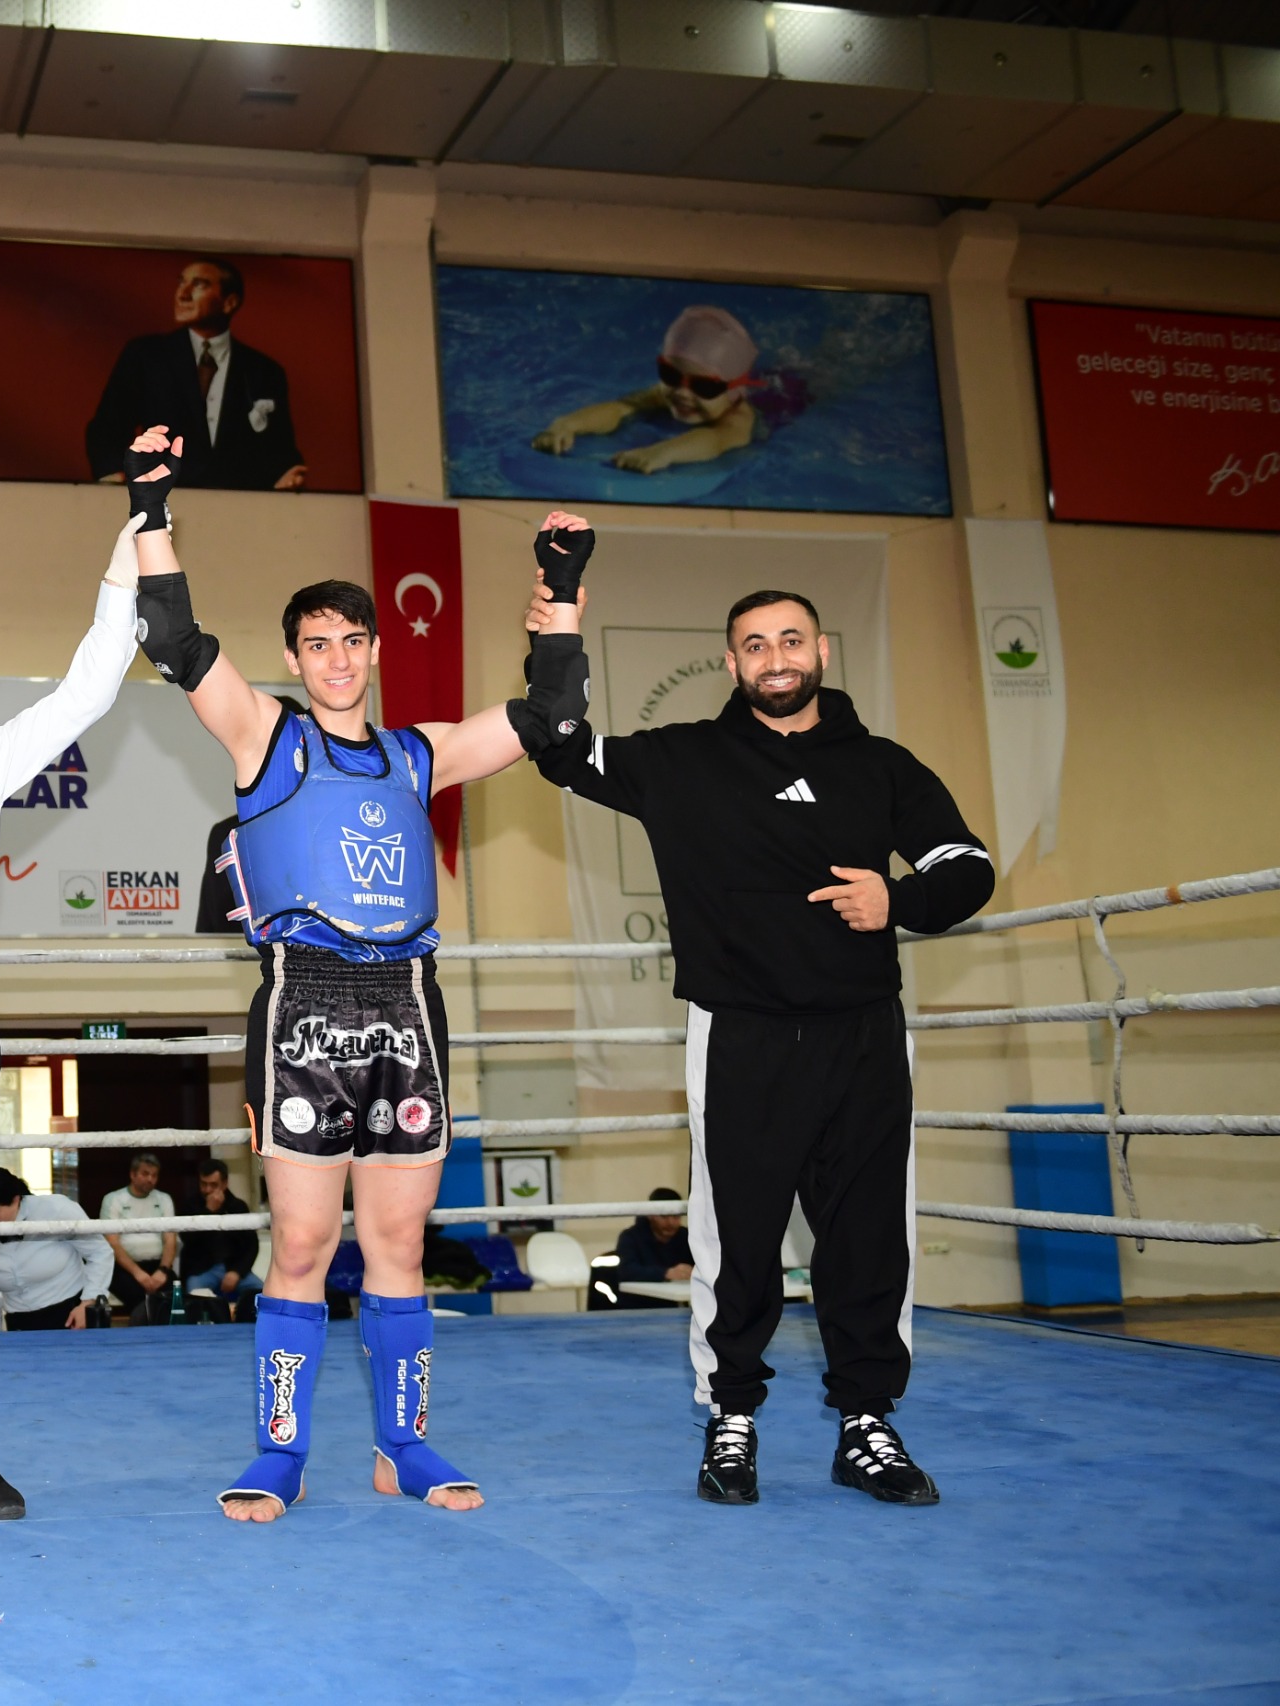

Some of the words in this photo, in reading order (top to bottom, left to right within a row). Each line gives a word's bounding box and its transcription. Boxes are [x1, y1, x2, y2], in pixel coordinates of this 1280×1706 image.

[1076, 352, 1166, 379] geleceği
[1224, 364, 1275, 386] genç
[1131, 389, 1156, 406] ve
[1163, 390, 1262, 414] enerjisine
[107, 871, 179, 888] ERKAN
[109, 889, 177, 908] AYDIN
[353, 892, 406, 908] WHITEFACE
[89, 1024, 119, 1033] EXIT
[397, 1359, 407, 1392] FIGHT
[396, 1394, 406, 1427] GEAR
